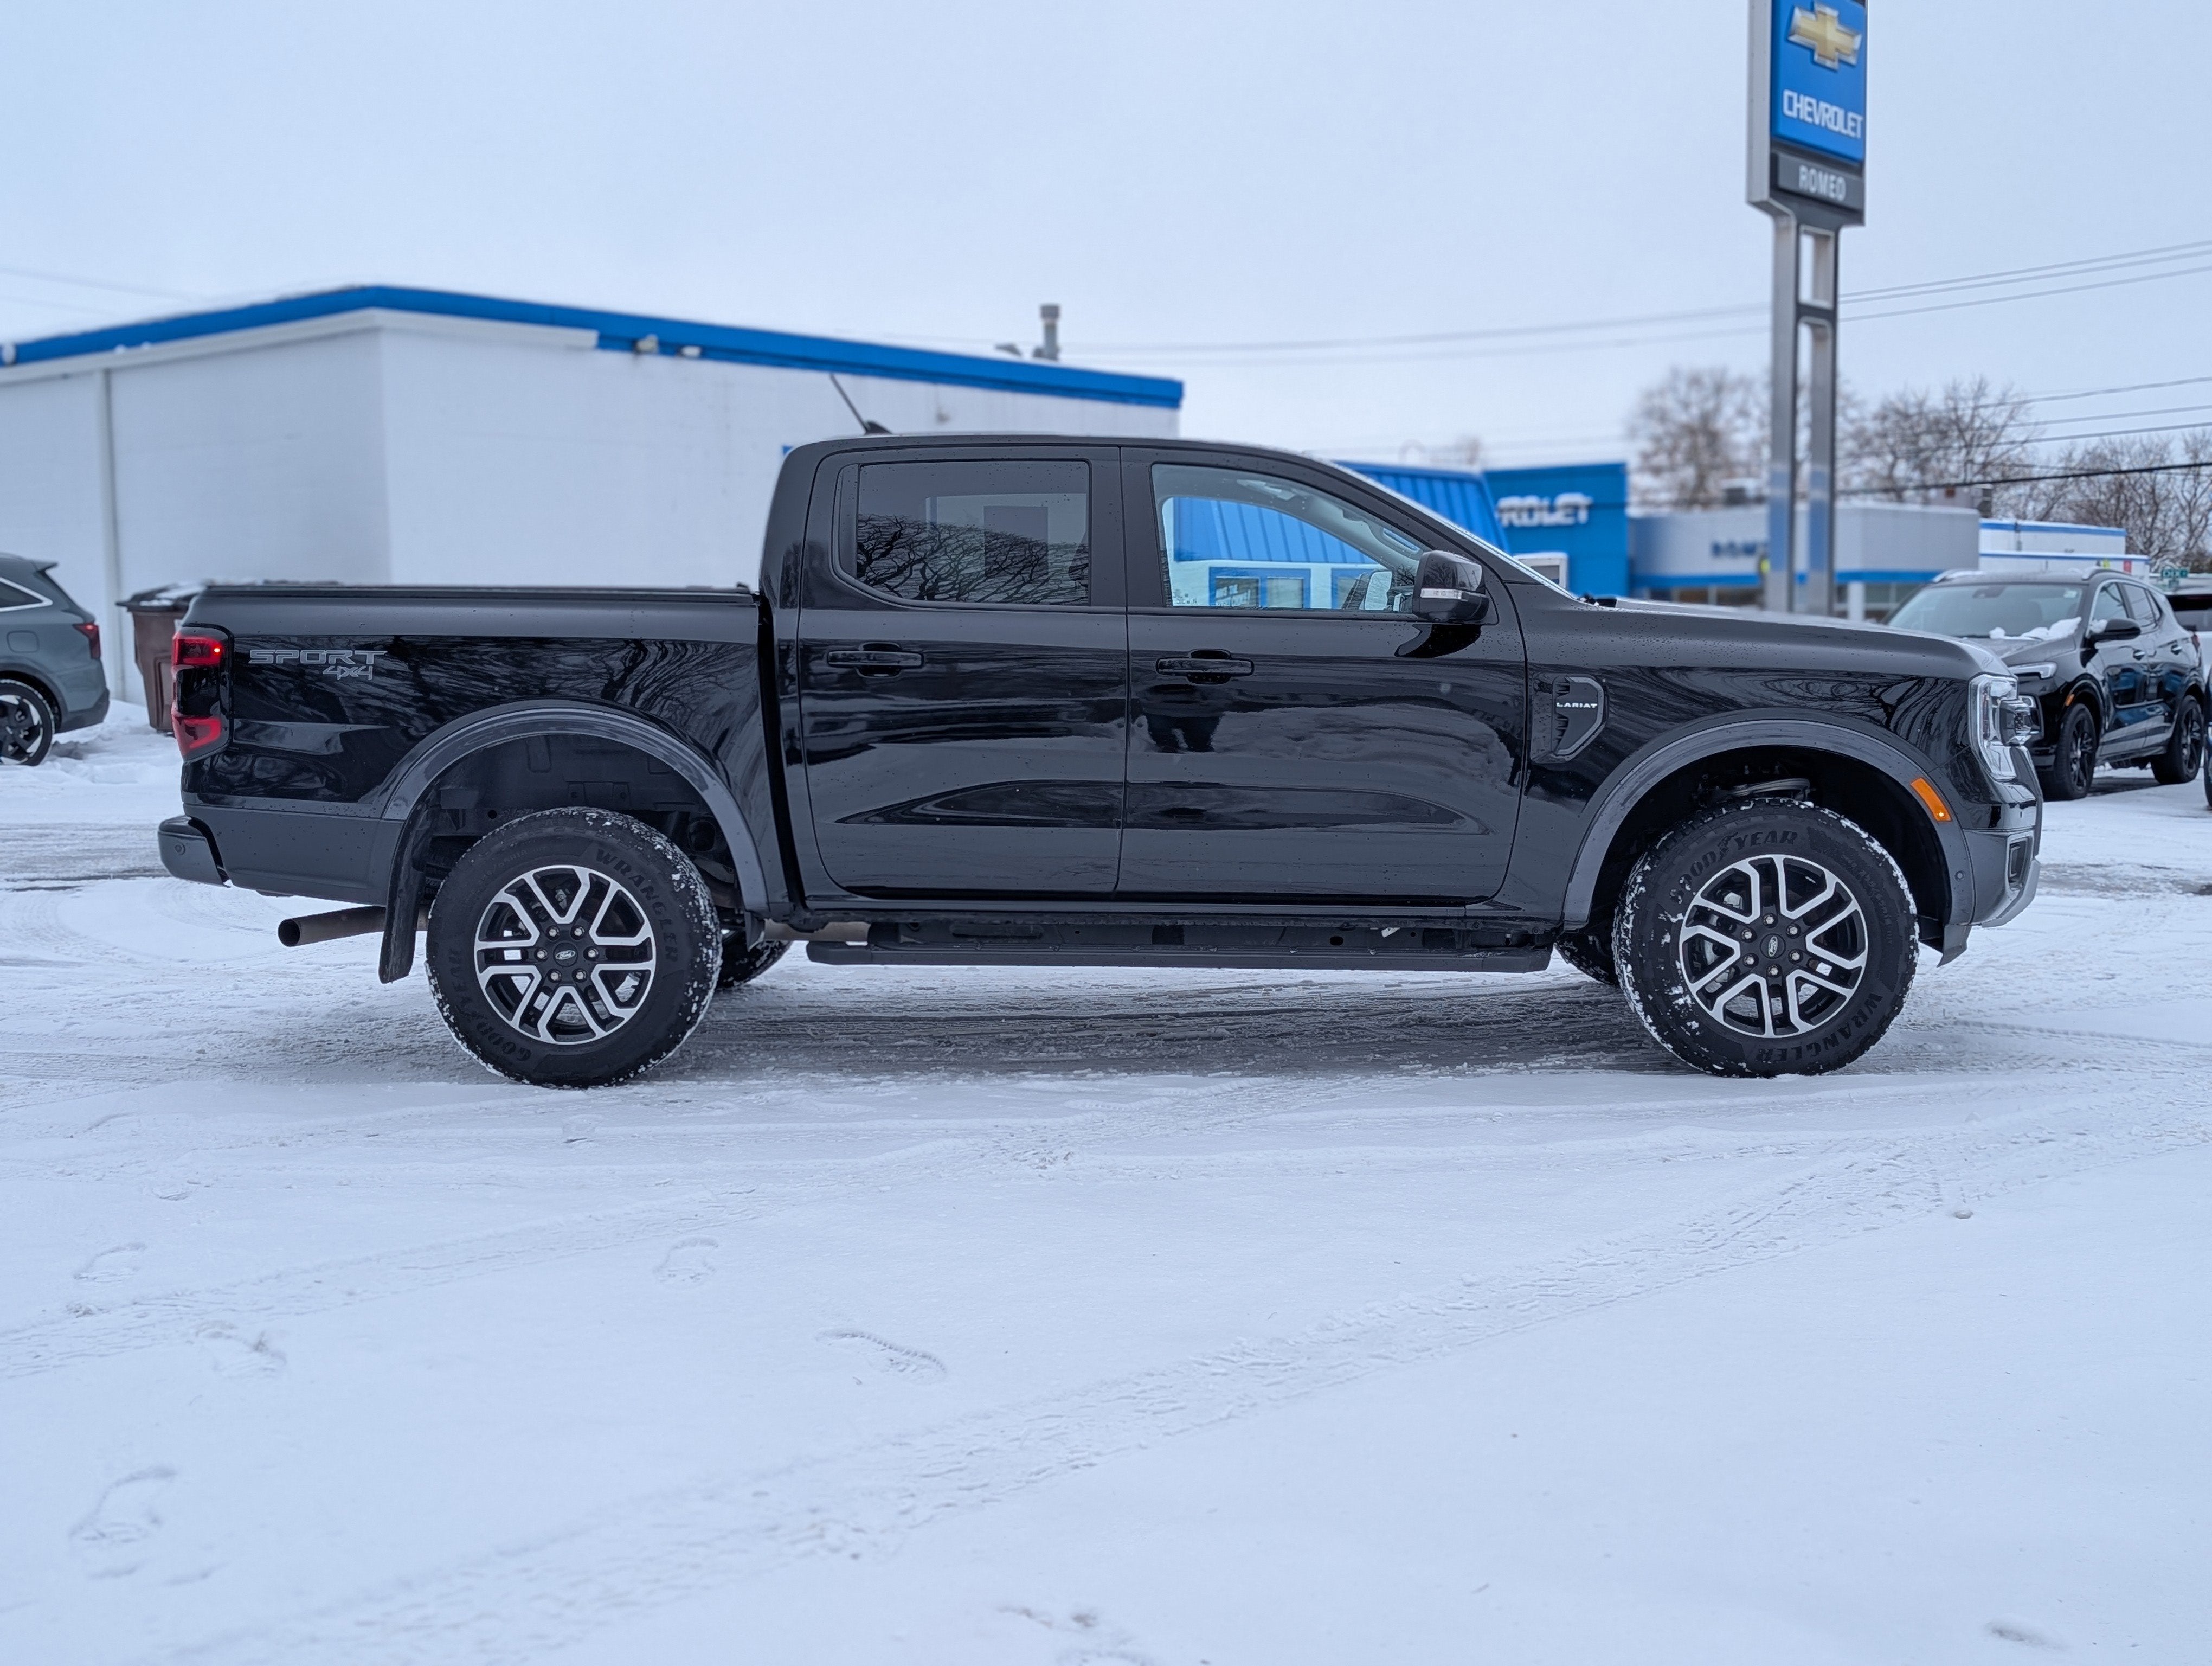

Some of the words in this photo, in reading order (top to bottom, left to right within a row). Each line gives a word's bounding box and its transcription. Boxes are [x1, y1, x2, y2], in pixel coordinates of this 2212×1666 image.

[1783, 89, 1863, 139] CHEVROLET
[1799, 165, 1846, 201] ROMEO
[1497, 492, 1593, 528] ROLET
[249, 649, 387, 665] SPORT
[596, 848, 678, 963] WRANGLER
[556, 950, 575, 959] Ford
[1756, 992, 1883, 1063] WRANGLER
